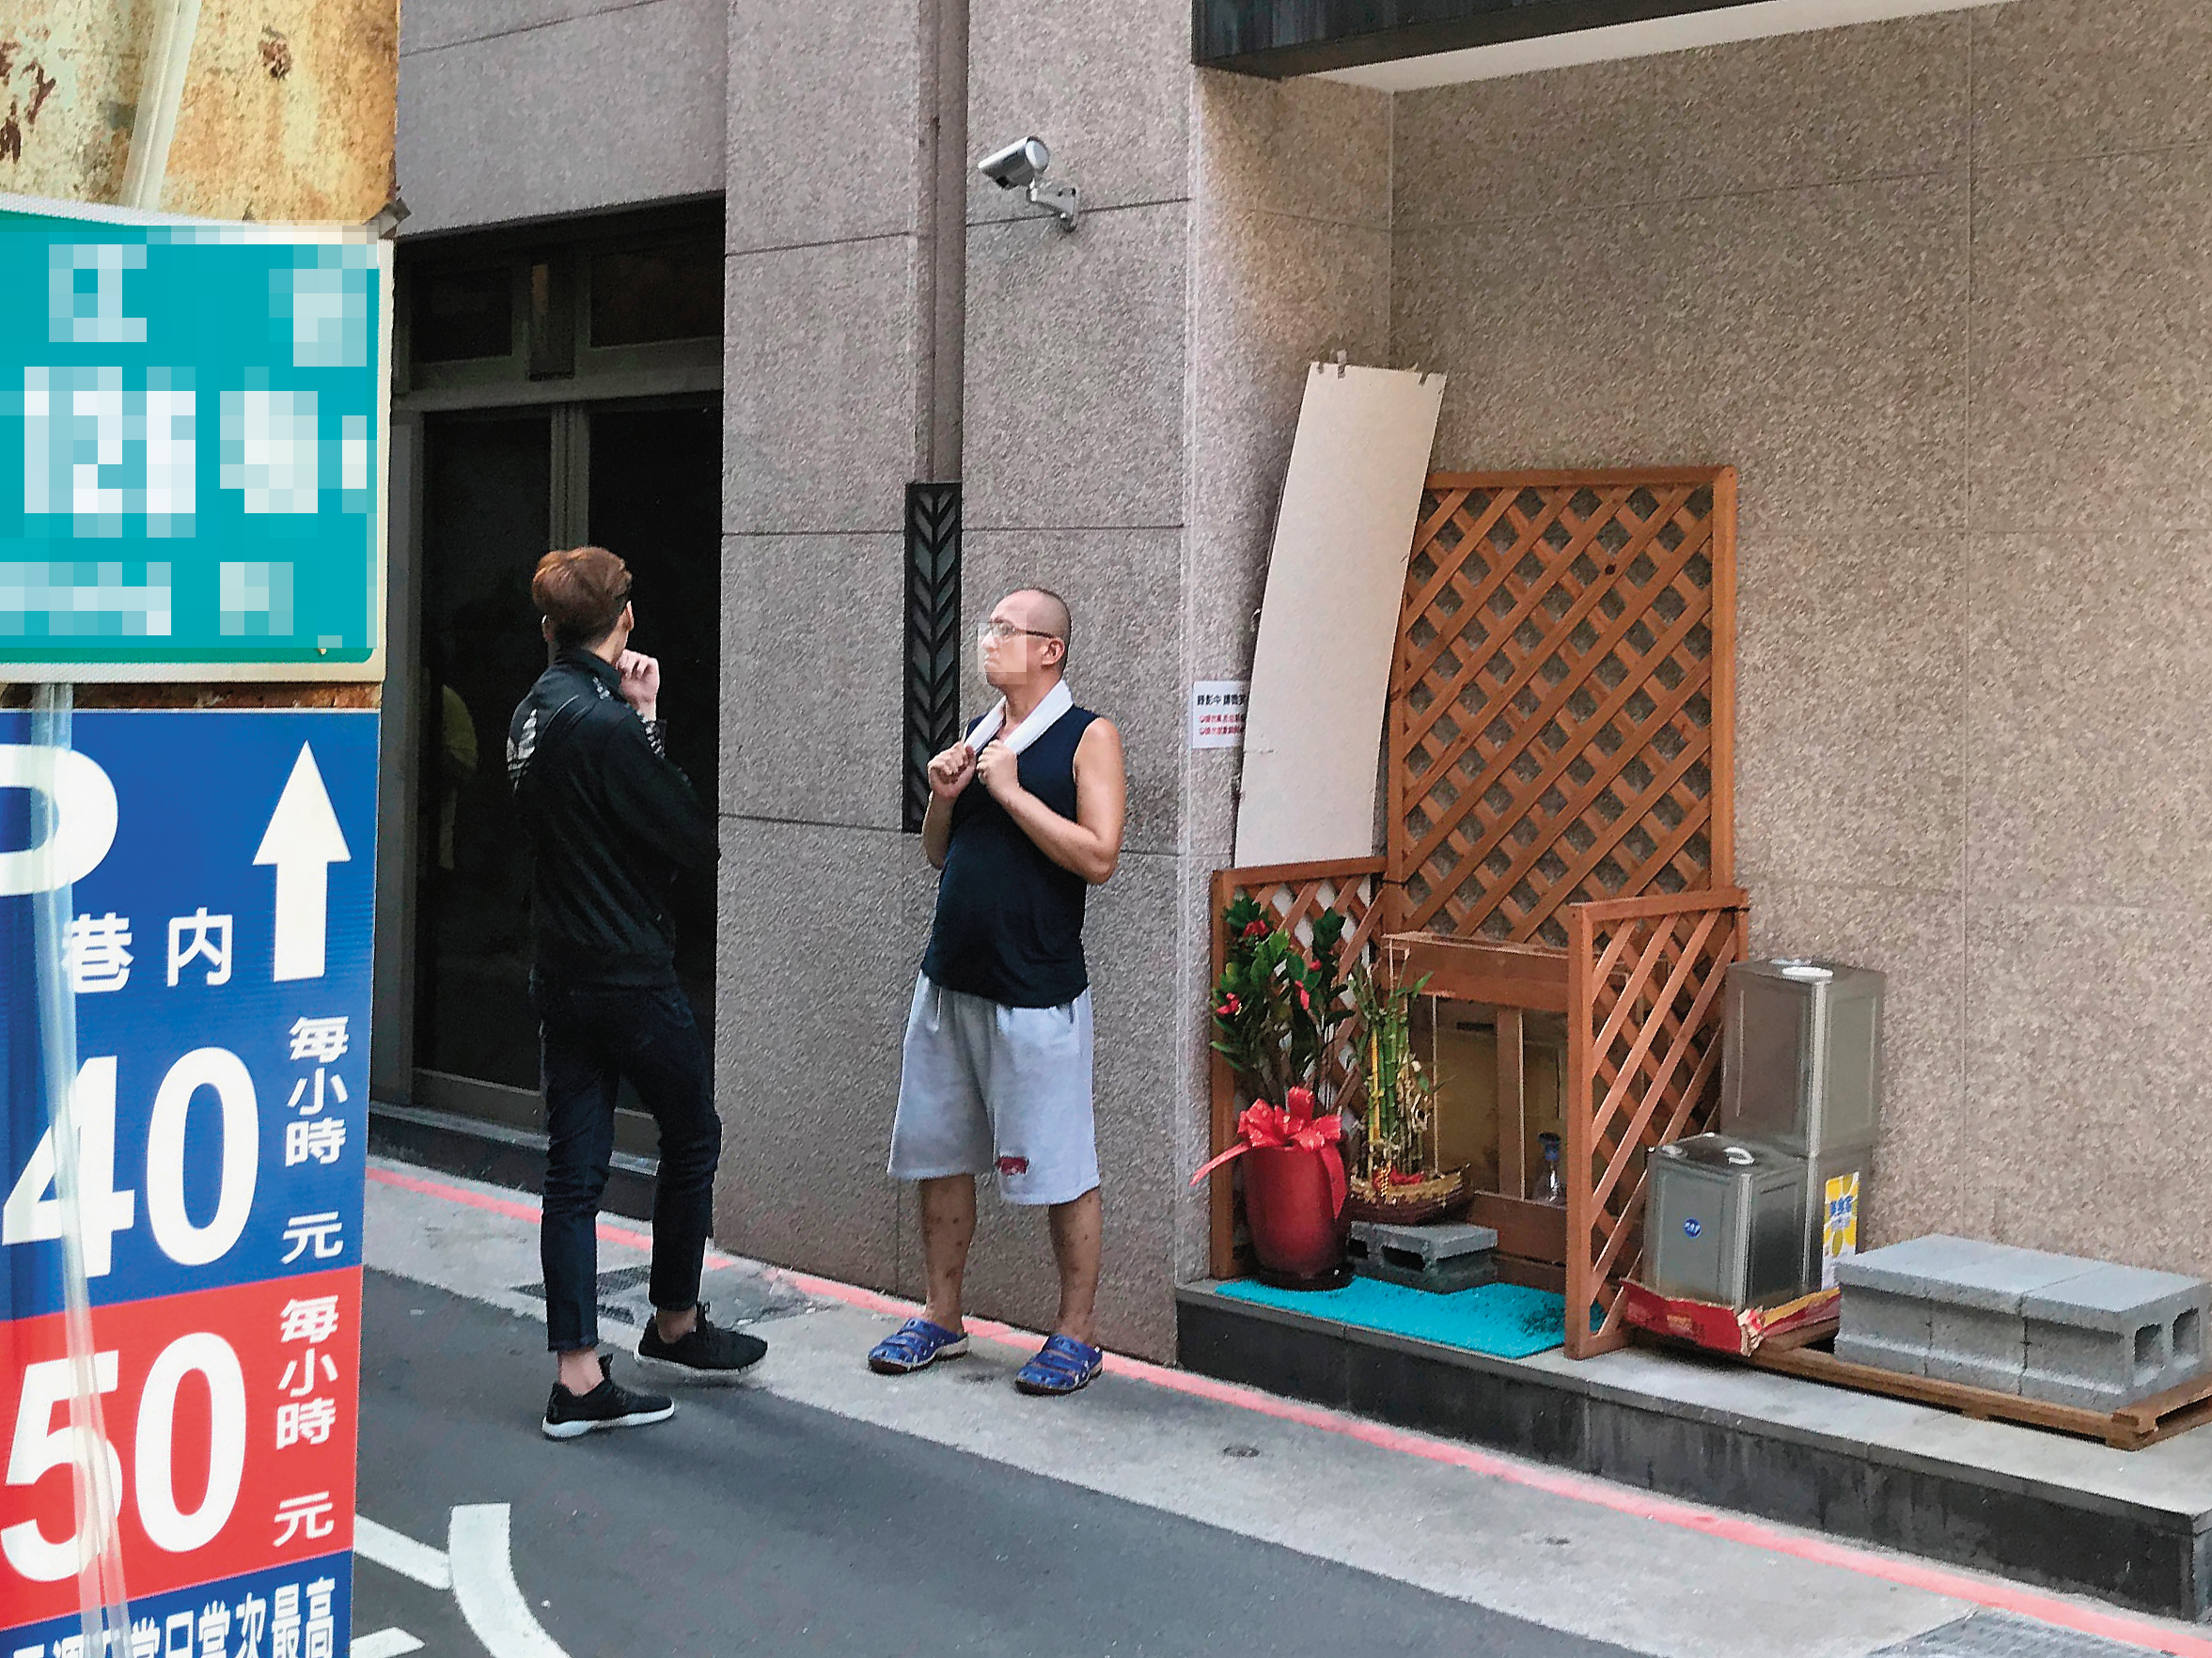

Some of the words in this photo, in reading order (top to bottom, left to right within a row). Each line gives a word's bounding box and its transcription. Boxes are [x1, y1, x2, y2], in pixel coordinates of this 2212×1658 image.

[2, 1046, 259, 1279] 40
[285, 1015, 350, 1166] 每小時
[280, 1211, 344, 1264] 元
[275, 1294, 338, 1449] 每小時
[0, 1332, 246, 1582] 50
[273, 1491, 335, 1548] 元
